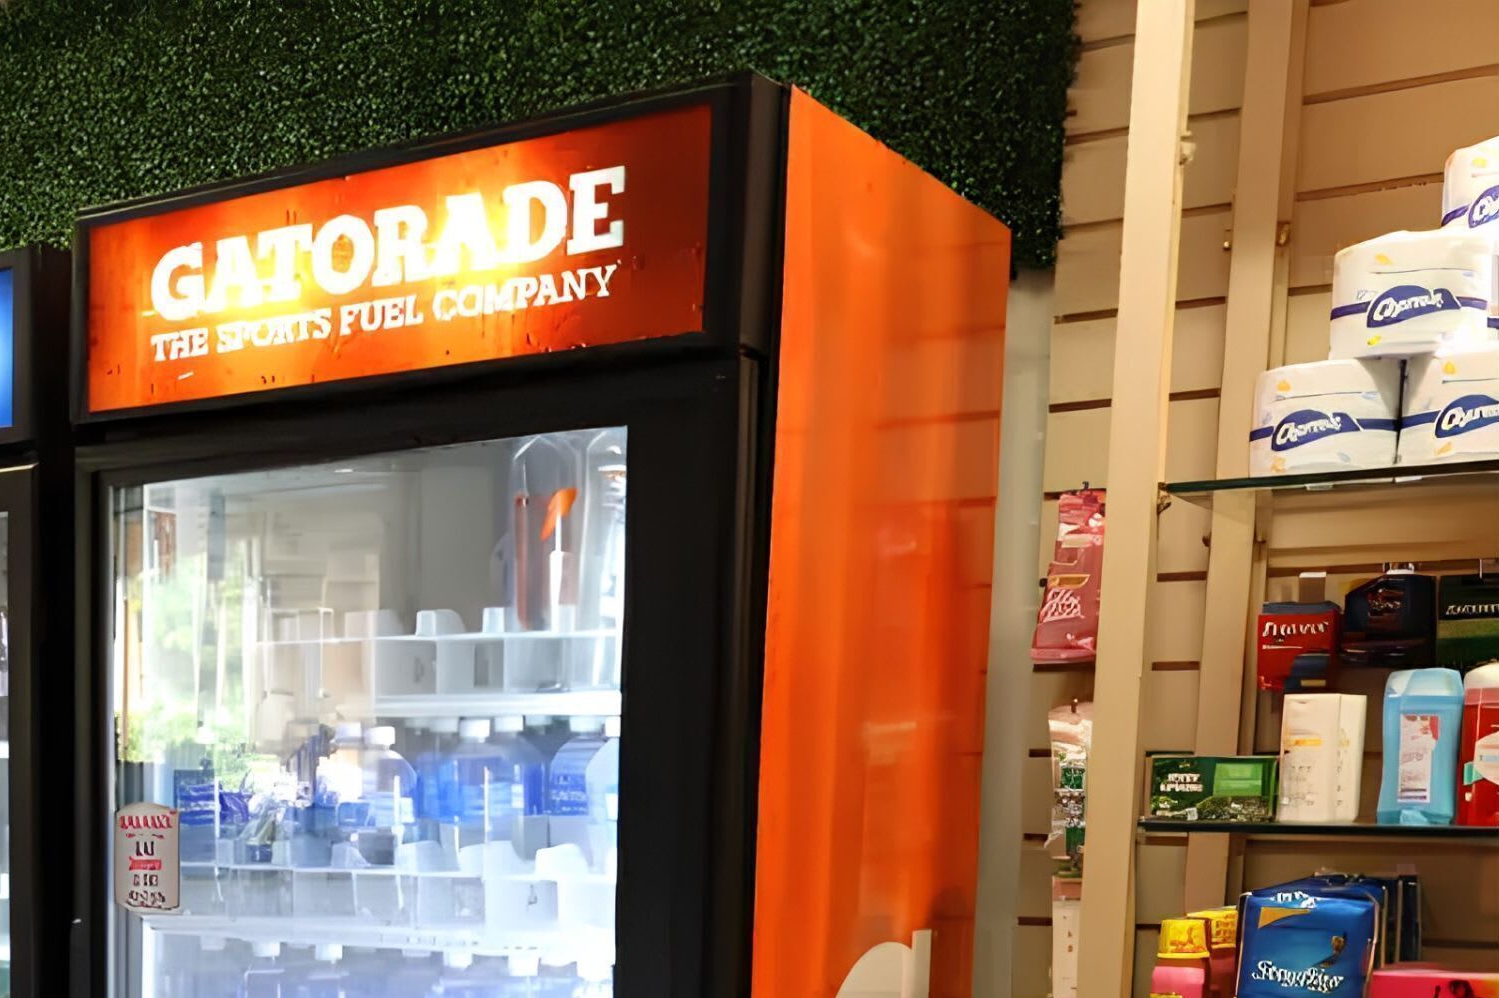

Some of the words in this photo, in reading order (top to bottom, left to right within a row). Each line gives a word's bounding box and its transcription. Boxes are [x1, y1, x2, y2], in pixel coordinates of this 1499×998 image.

[149, 164, 626, 321] GATORADE
[150, 326, 209, 362] THE
[216, 306, 333, 354] SPORTS
[339, 294, 424, 336] FUEL
[432, 263, 619, 321] COMPANY
